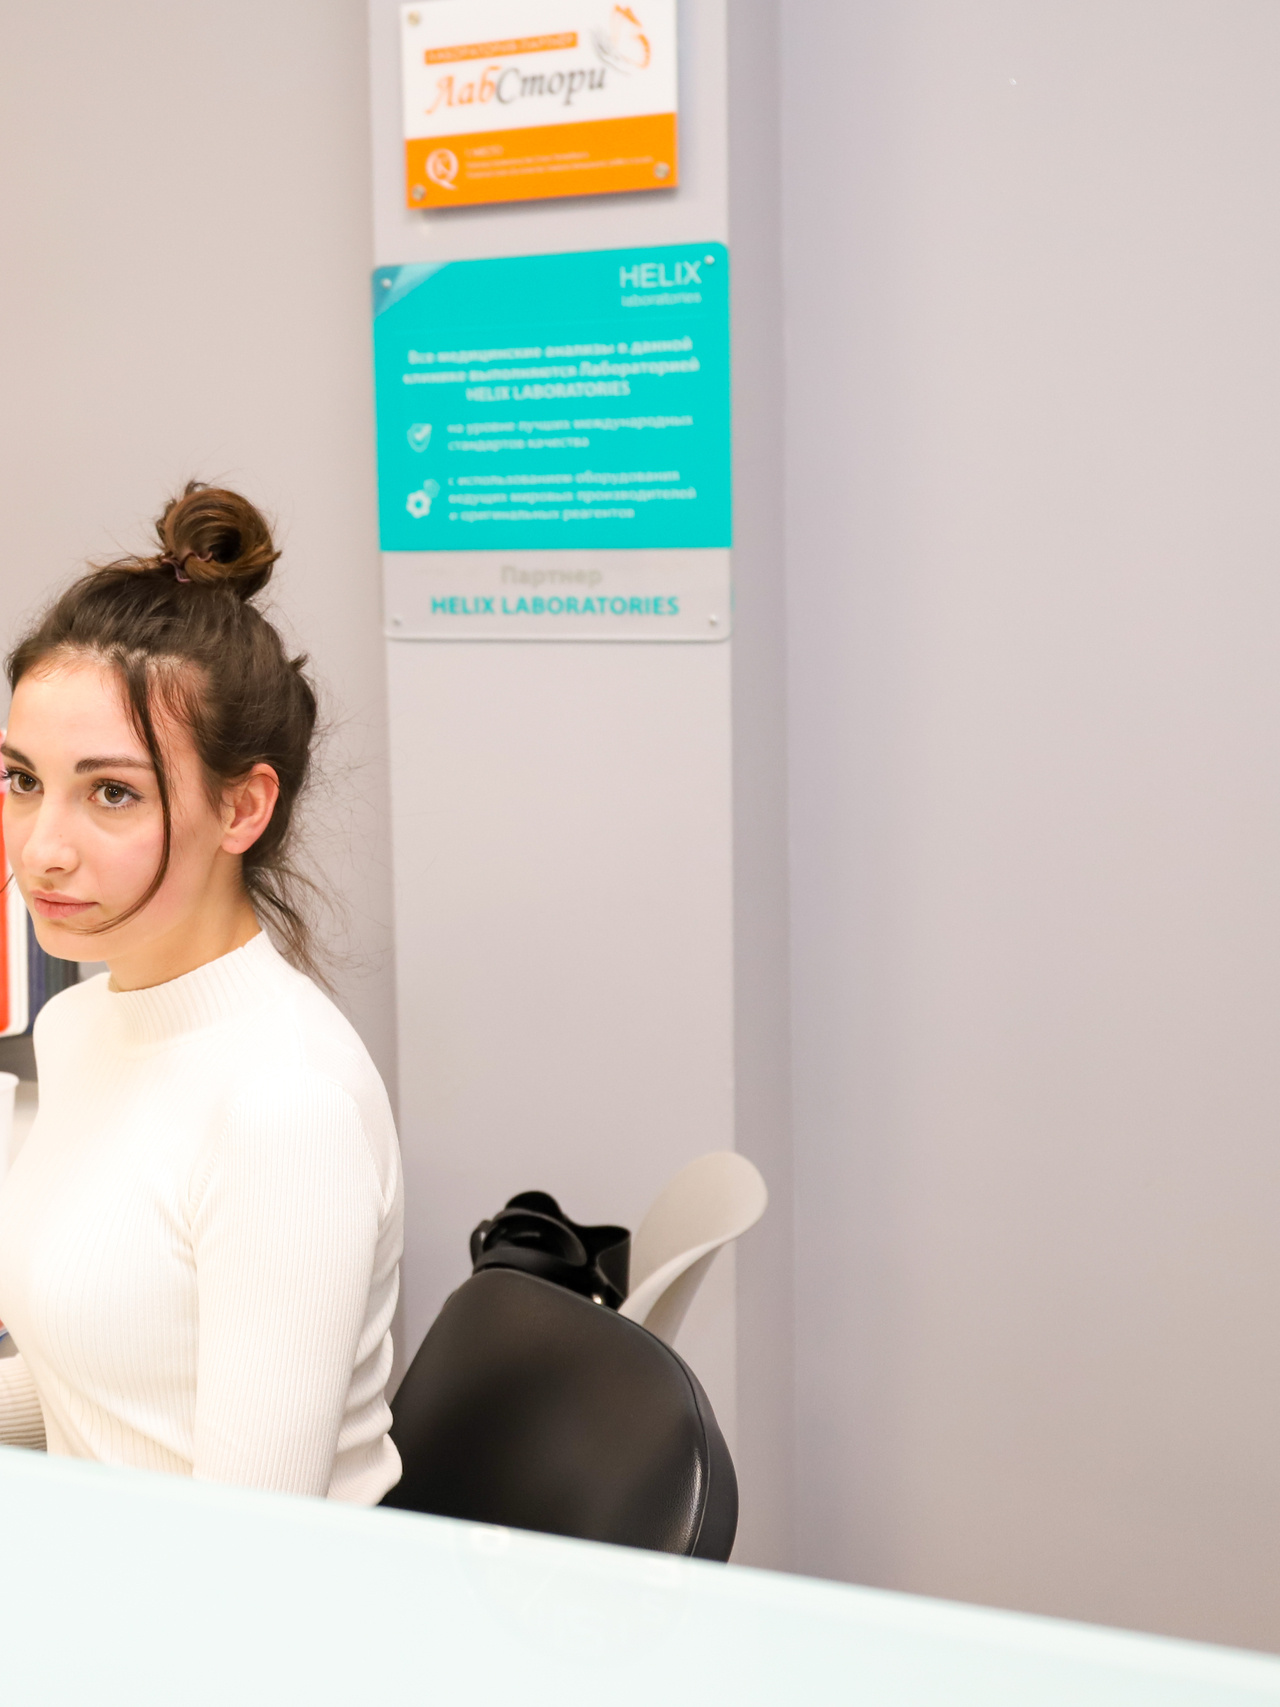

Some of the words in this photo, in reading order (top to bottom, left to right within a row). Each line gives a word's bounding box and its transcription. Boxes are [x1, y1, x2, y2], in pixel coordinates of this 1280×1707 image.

[425, 65, 607, 115] ЛабСтори
[619, 260, 702, 288] HELIX
[621, 291, 702, 307] laboratories
[407, 349, 435, 365] Все
[545, 343, 615, 359] анализы
[630, 335, 693, 356] данной
[465, 386, 511, 402] HELIX
[512, 379, 631, 401] LABORATORIES
[500, 564, 603, 588] Партнер
[430, 595, 495, 615] HELIX
[501, 595, 680, 615] LABORATORIES
